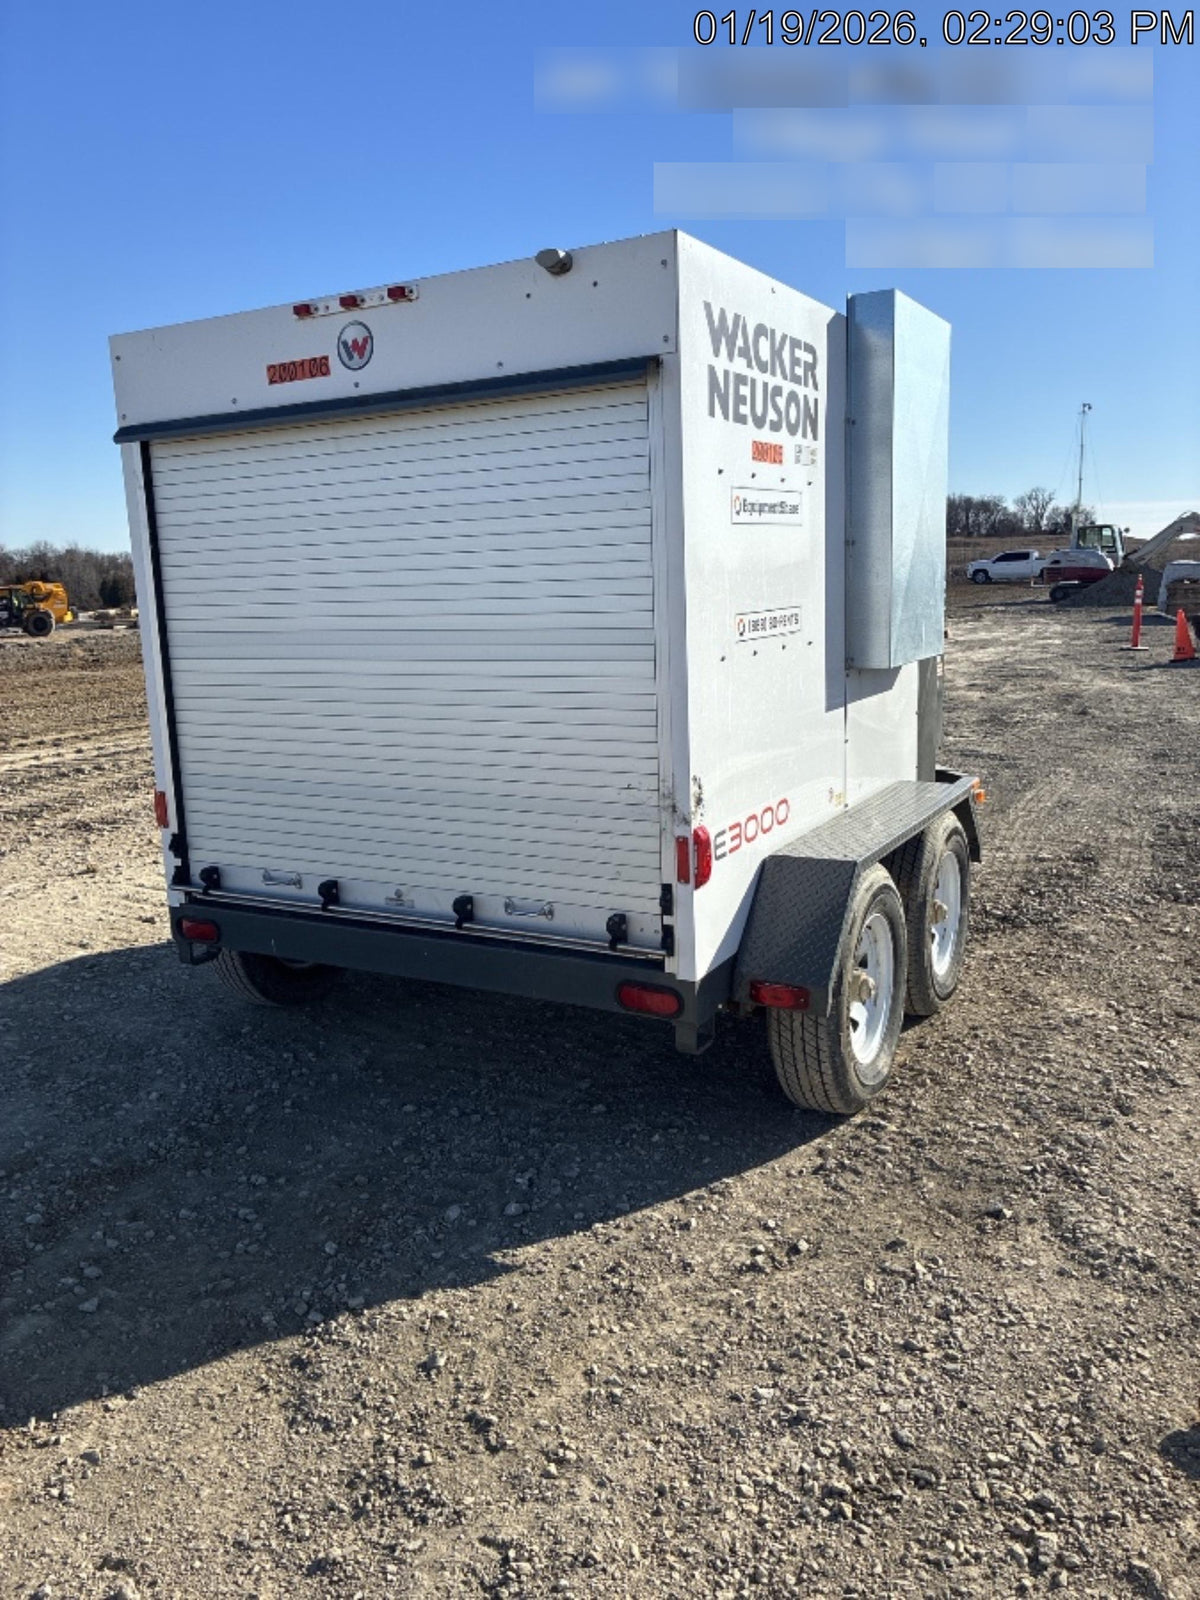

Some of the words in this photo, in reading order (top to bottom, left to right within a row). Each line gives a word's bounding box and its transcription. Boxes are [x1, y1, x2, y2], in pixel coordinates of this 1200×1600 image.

[267, 355, 331, 385] 200106
[703, 300, 819, 392] WACKER
[708, 364, 819, 441] NEUSON
[714, 798, 790, 861] E3000
